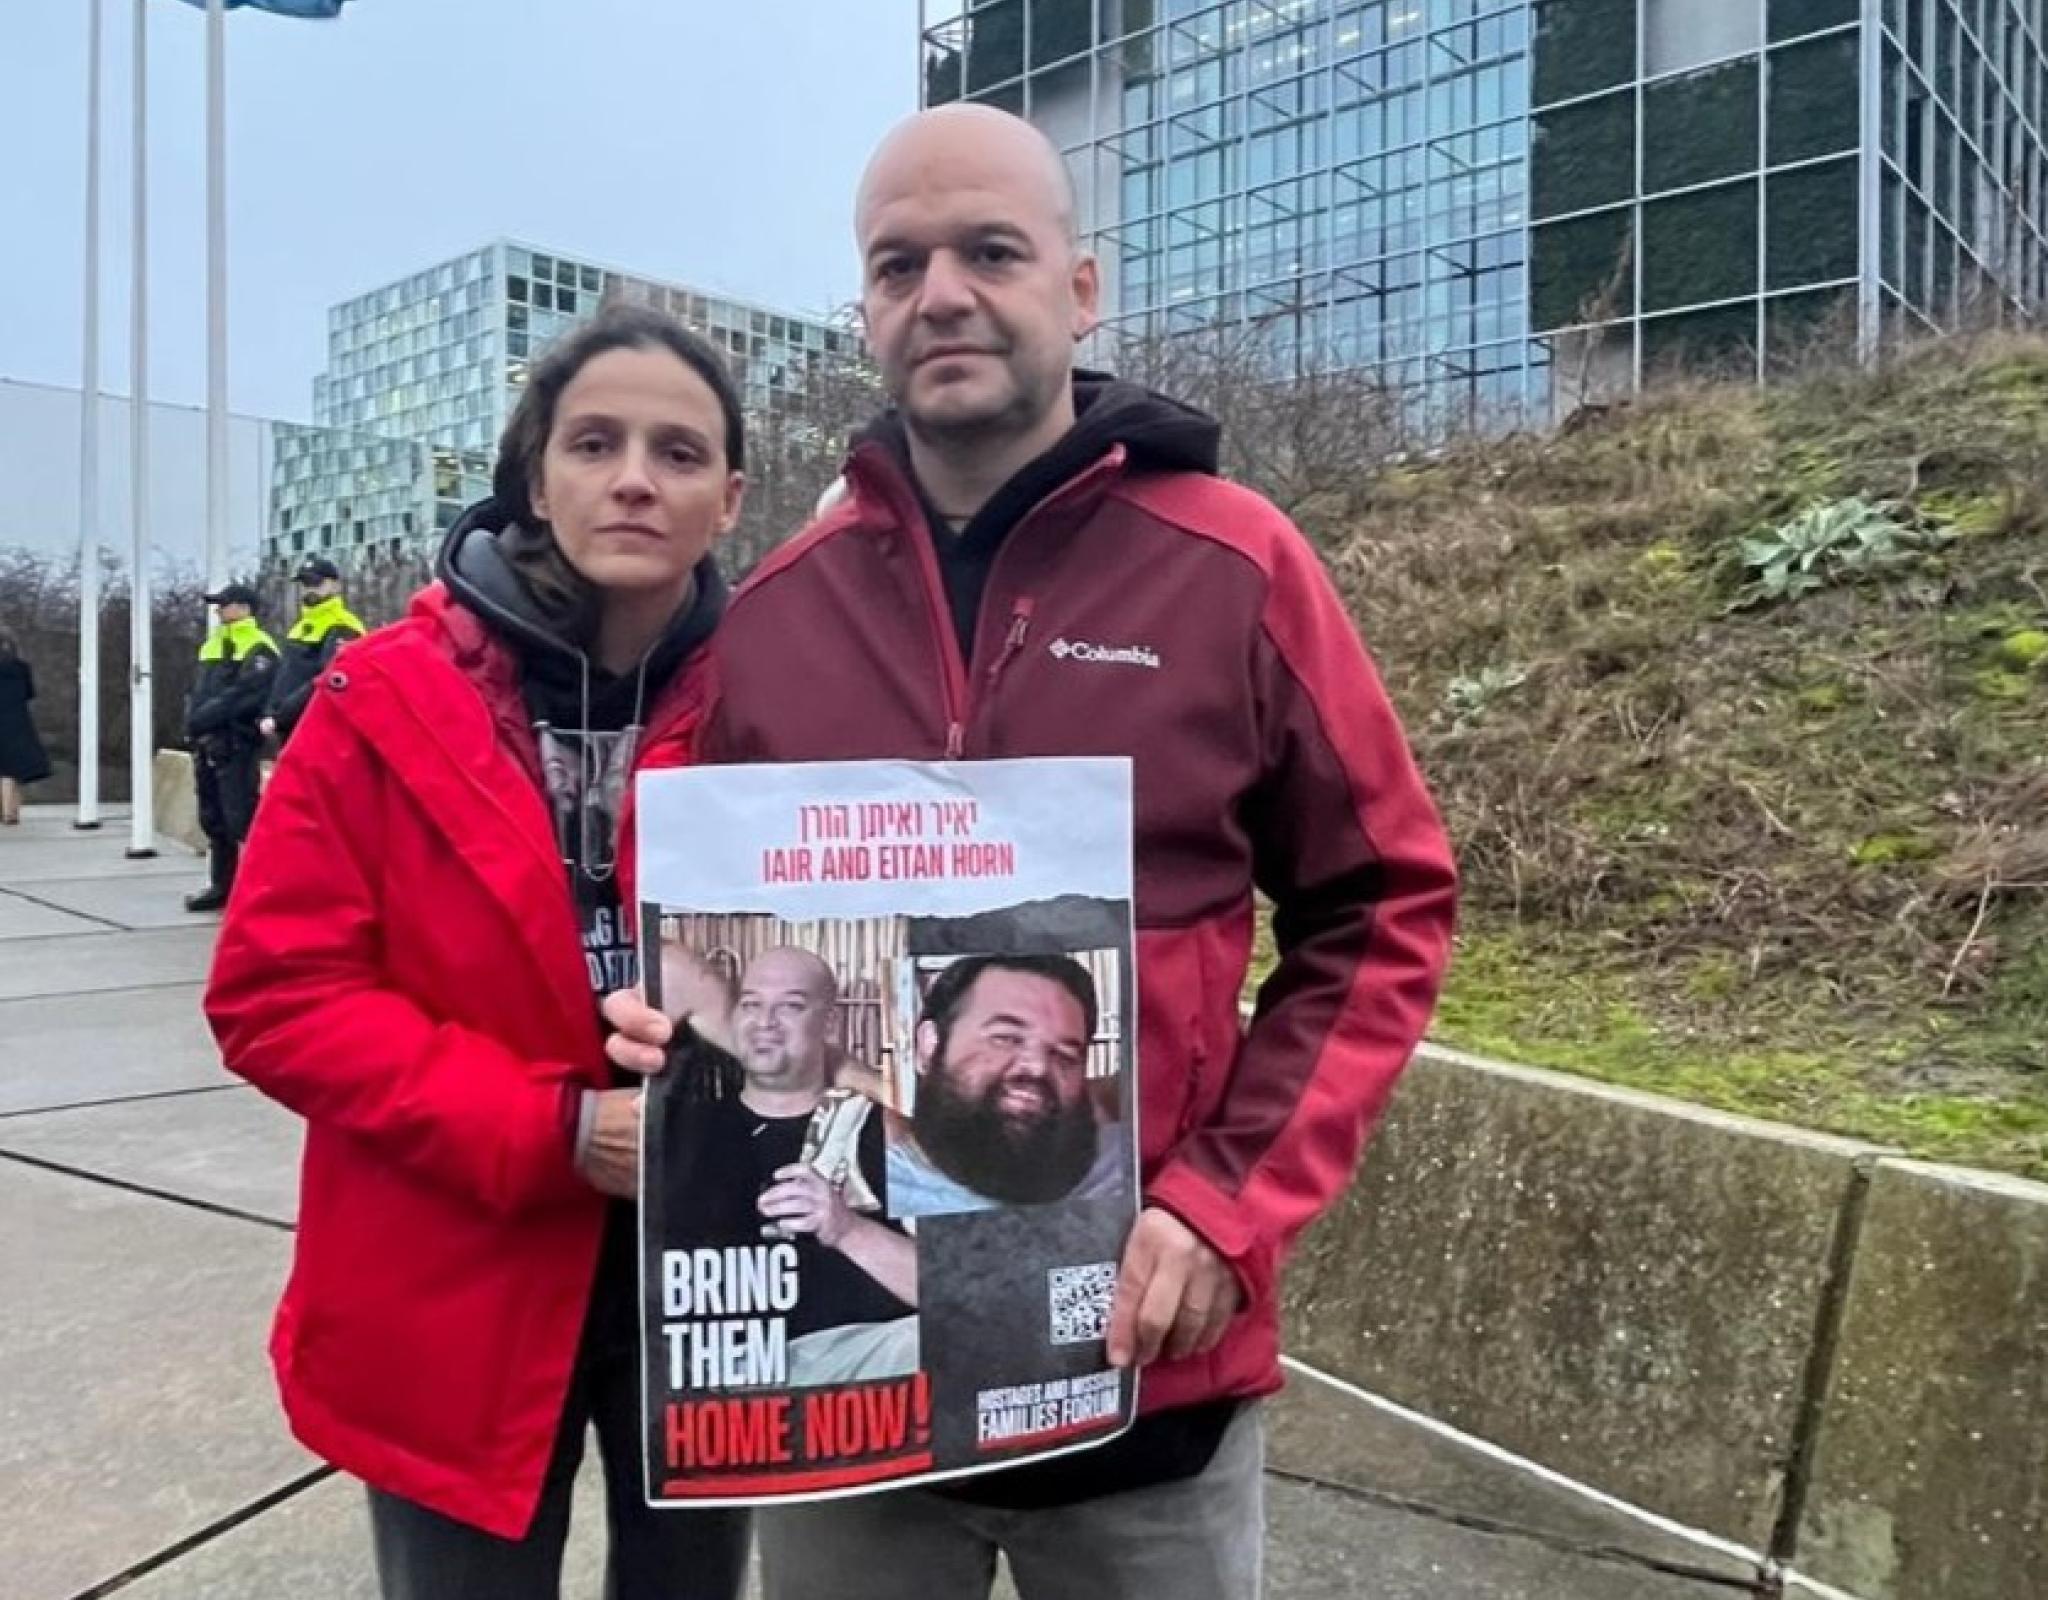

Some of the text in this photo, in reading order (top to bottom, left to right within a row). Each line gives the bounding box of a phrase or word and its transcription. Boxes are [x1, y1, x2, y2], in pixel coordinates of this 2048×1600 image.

[799, 800, 978, 842] יאיר ואיתן הורן
[762, 842, 1014, 882] IAIR AND EITAN HORN
[662, 1243, 798, 1317] BRING
[662, 1318, 787, 1390] THEM
[666, 1372, 931, 1467] HOME NOW!
